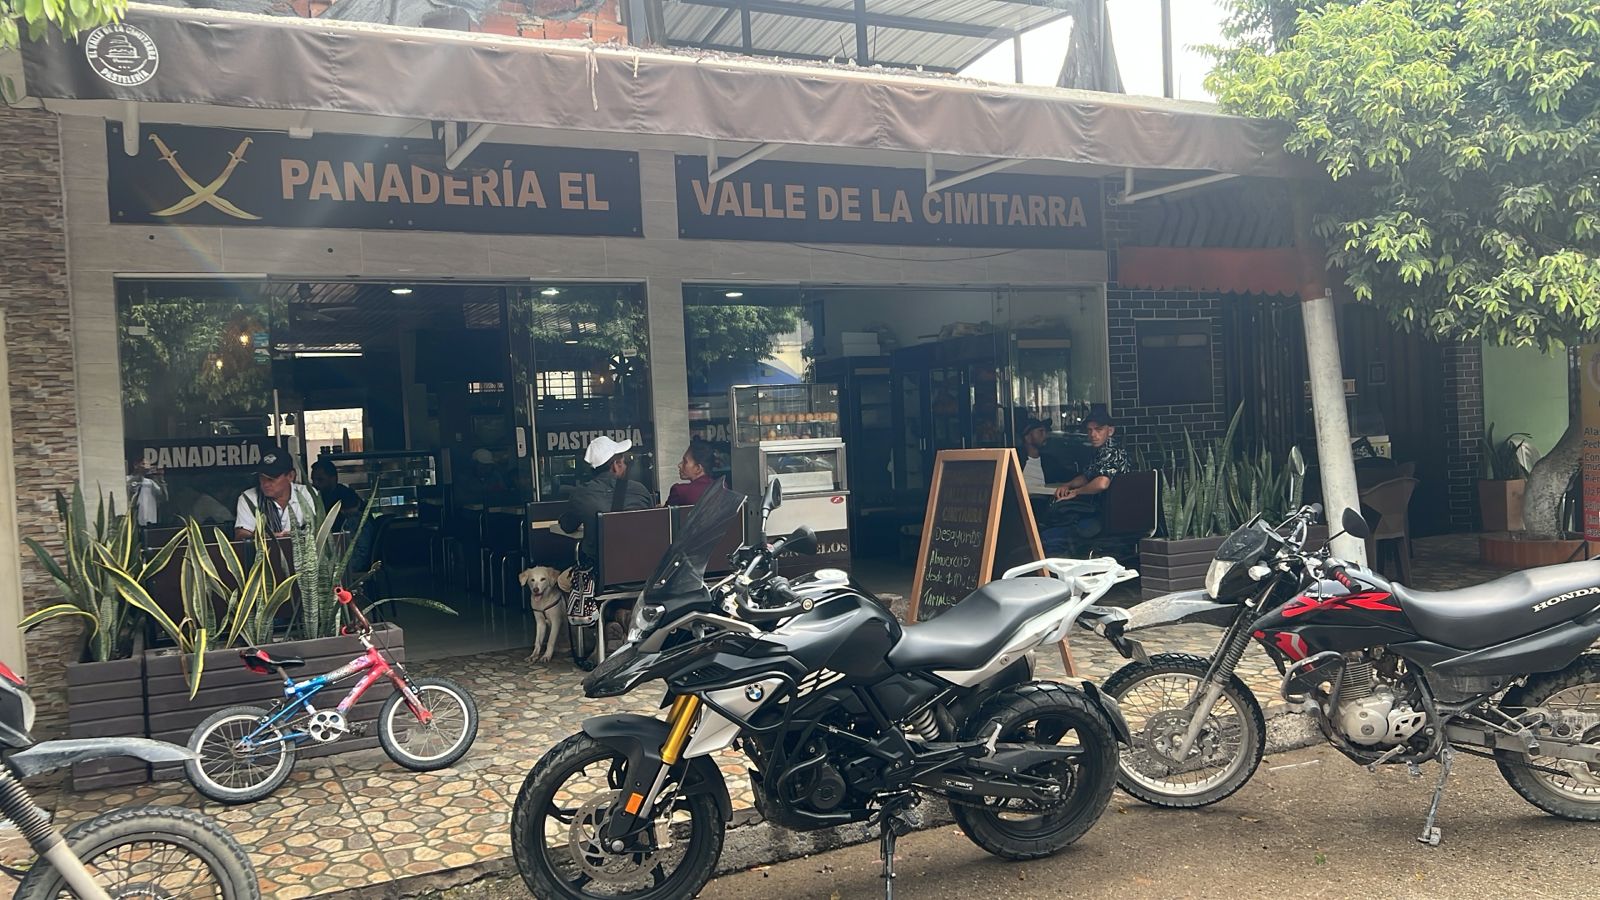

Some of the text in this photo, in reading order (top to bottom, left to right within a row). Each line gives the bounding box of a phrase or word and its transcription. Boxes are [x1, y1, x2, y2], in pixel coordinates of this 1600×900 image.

[281, 159, 609, 211] PANADERÍA EL
[692, 180, 1088, 227] VALLE DE LA CIMITARRA
[143, 440, 262, 469] PANADERÍA
[1532, 587, 1600, 613] HONDA
